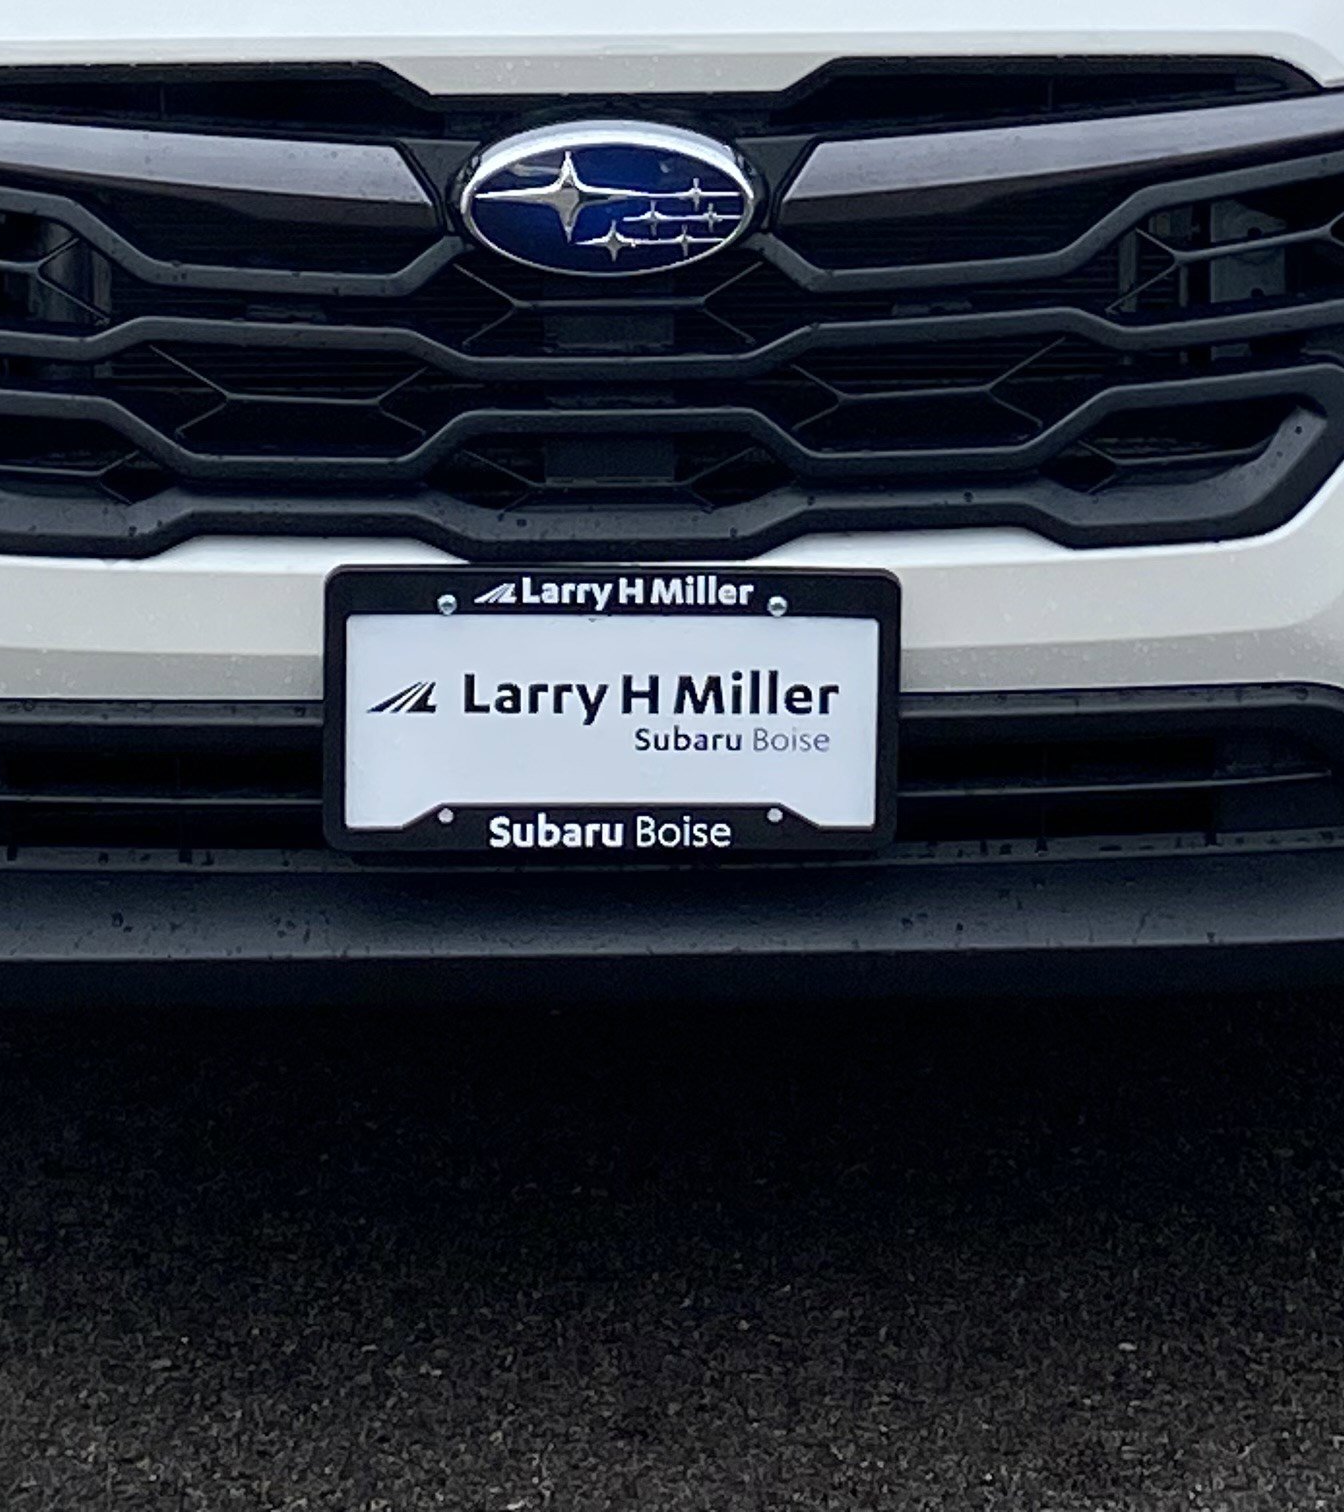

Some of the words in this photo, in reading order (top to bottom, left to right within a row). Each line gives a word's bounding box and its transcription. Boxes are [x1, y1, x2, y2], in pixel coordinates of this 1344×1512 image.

[522, 576, 613, 611] Larry
[618, 577, 644, 604] H
[650, 575, 754, 605] Miller
[463, 673, 609, 726] Larry
[621, 674, 660, 715] H
[673, 669, 840, 716] Miller
[634, 727, 743, 752] Subaru
[752, 727, 831, 752] Boise
[488, 813, 624, 849] Subaru
[636, 813, 732, 848] Boise
